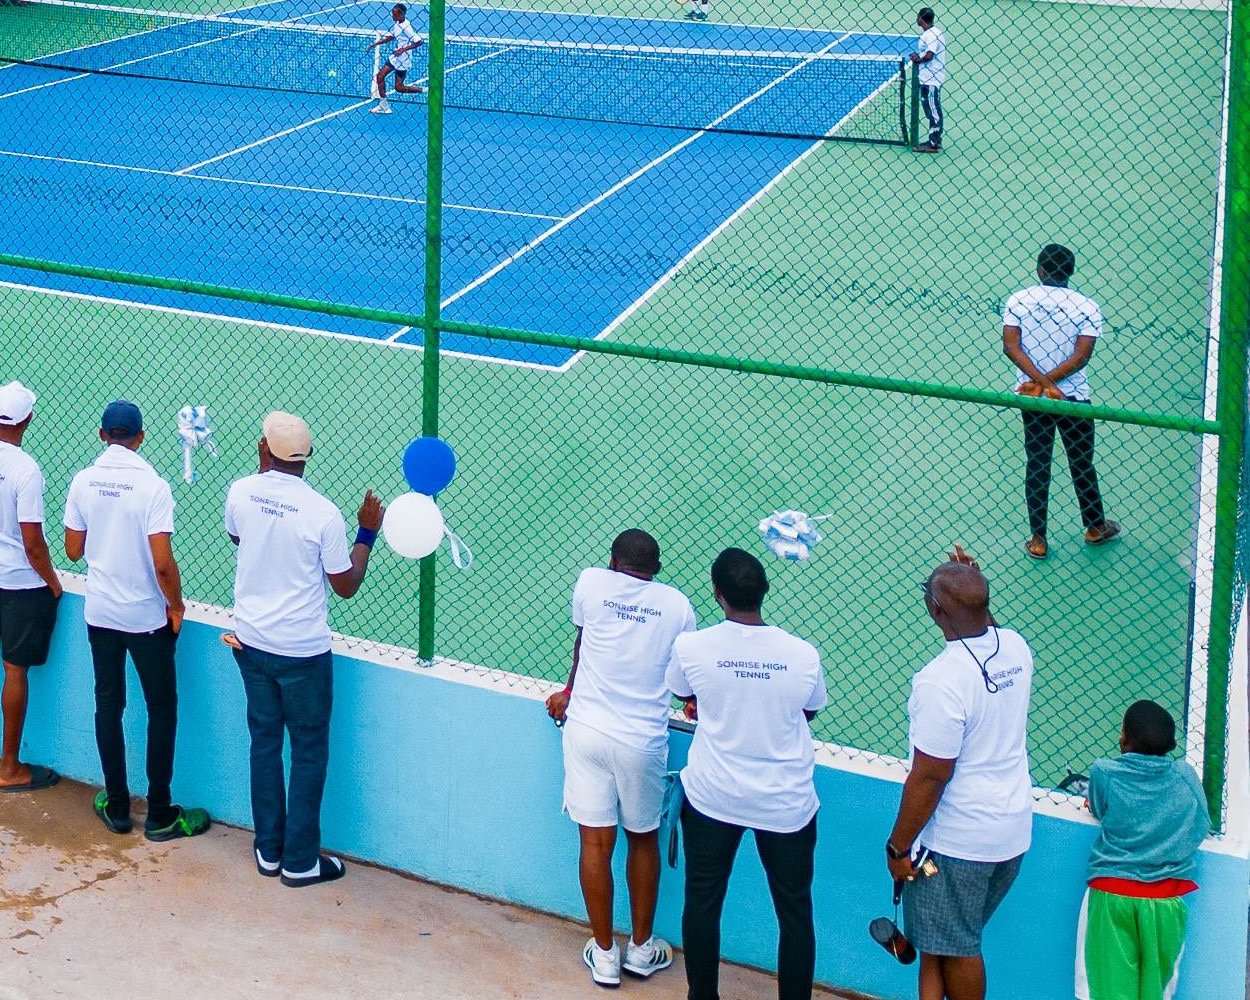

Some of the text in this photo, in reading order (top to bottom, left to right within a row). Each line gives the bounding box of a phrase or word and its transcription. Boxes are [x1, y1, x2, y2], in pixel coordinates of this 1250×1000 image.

[99, 490, 121, 498] TENNIS
[250, 494, 299, 513] SONRISE HIGH
[261, 506, 285, 518] TENNIS
[603, 599, 662, 618] SONRISE HIGH
[616, 611, 646, 624] TENNIS
[717, 659, 788, 672] SONRISE HIGH
[734, 670, 771, 680] TENNIS
